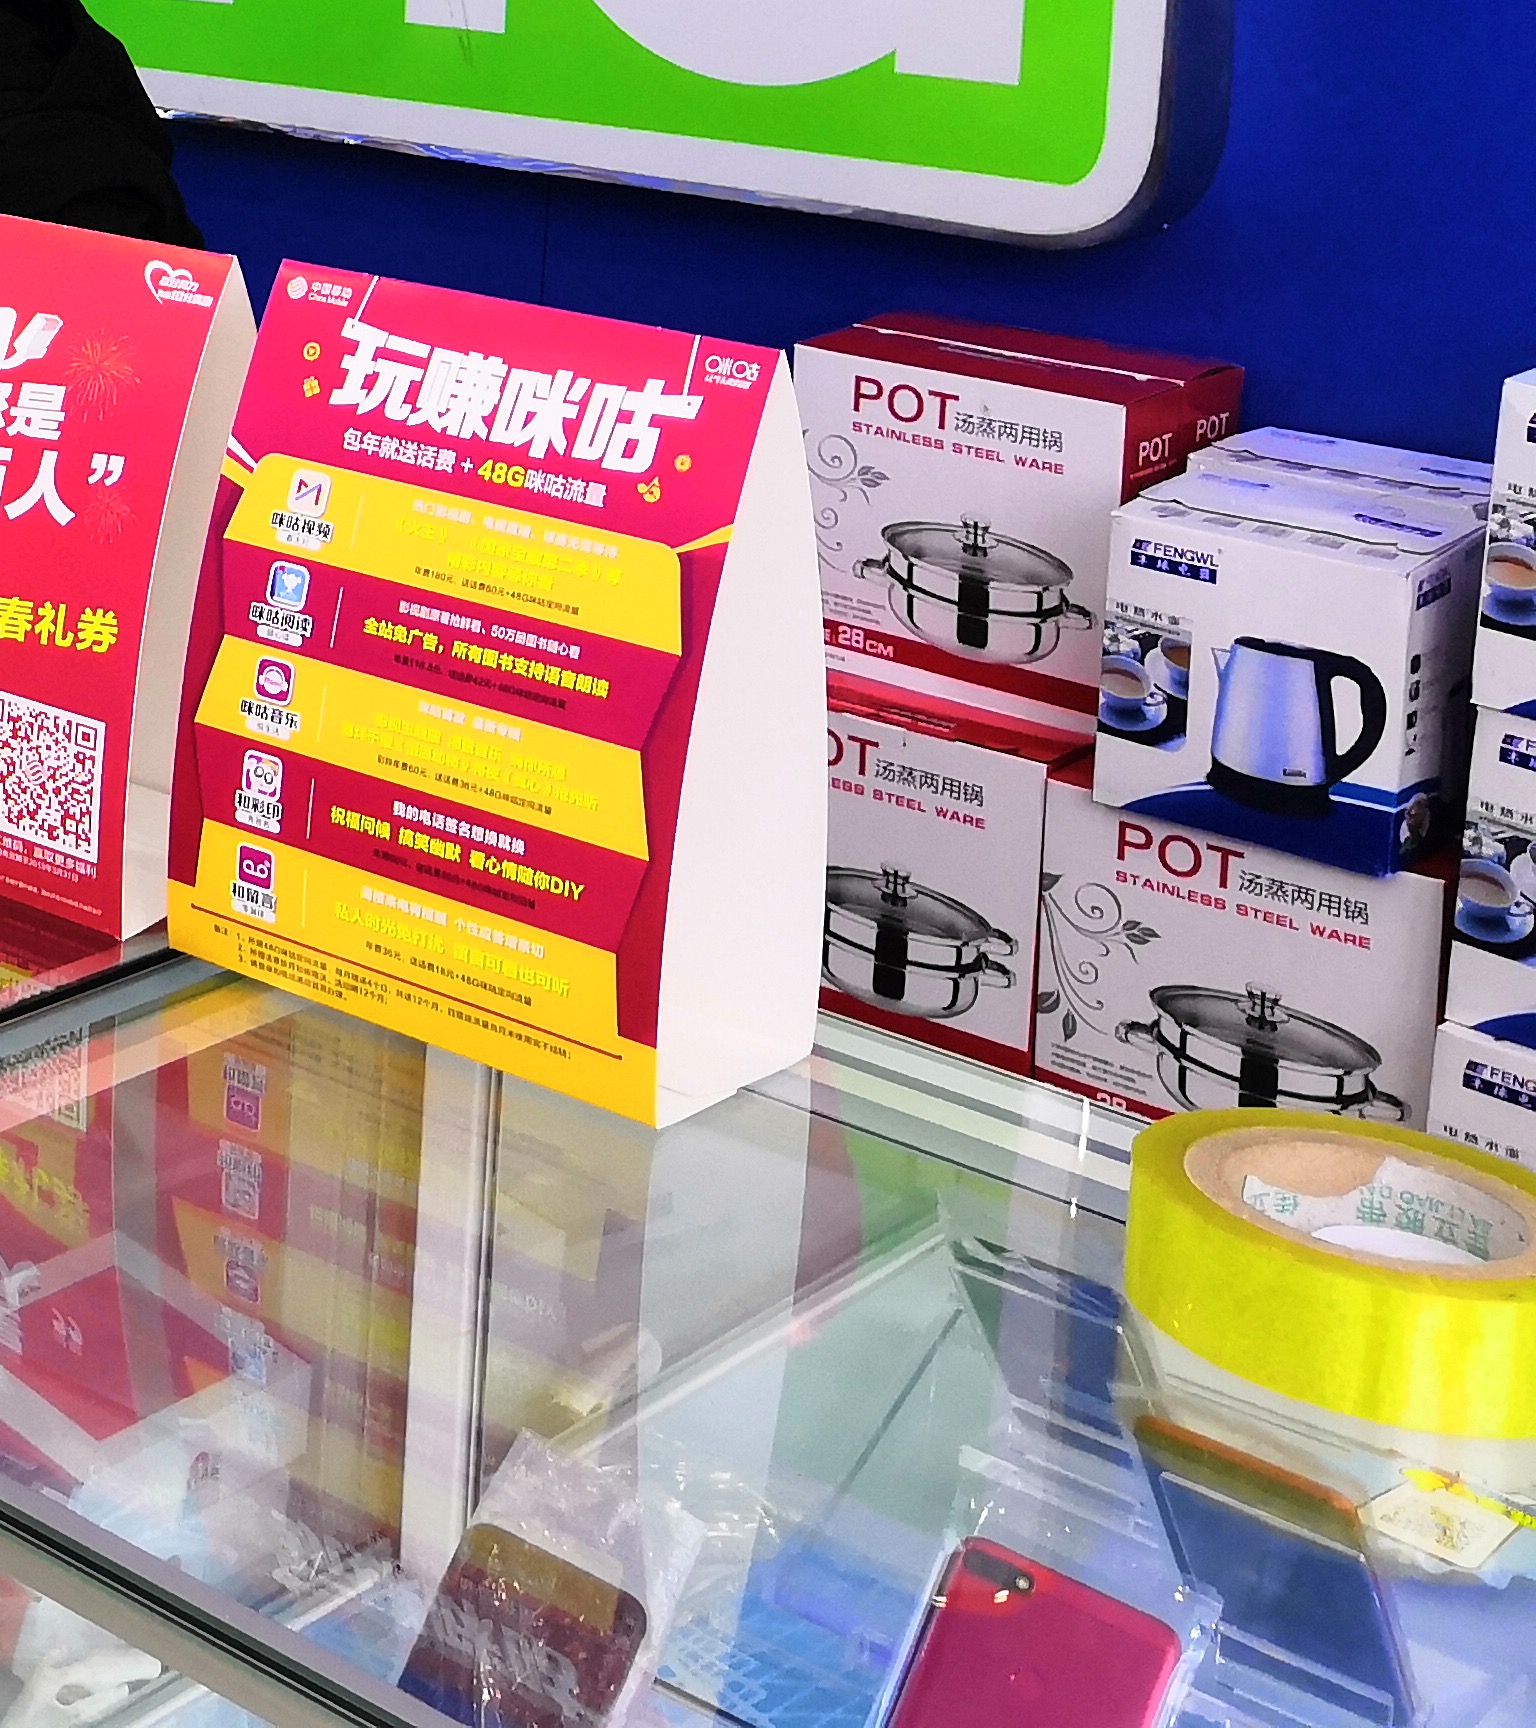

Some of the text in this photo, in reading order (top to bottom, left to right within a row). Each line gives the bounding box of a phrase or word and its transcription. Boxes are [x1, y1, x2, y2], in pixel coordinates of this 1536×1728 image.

[311, 281, 352, 300] 中国移动
[329, 317, 703, 474] 玩赚咪咕
[852, 375, 960, 430] POT
[852, 421, 1065, 475] STAINLESS STEEL WARE
[954, 411, 1064, 453] 汤蒸两用锅
[1196, 412, 1230, 442] POT
[343, 427, 457, 476] 包年就送话费
[478, 458, 607, 509] 48G咪咕流量
[1138, 433, 1173, 467] POT
[270, 511, 332, 542] 咪咕视频
[1154, 543, 1219, 568] FENGWL
[251, 604, 311, 636] 咪咕阅读
[240, 699, 299, 730] 咪咕音乐
[874, 757, 984, 807] 汤蒸两用锅
[873, 788, 986, 831] STEEL WARE
[1116, 821, 1244, 890] POT
[1115, 869, 1371, 951] STAINLESS STEEL WARE
[1238, 869, 1371, 926] 汤蒸两用锅
